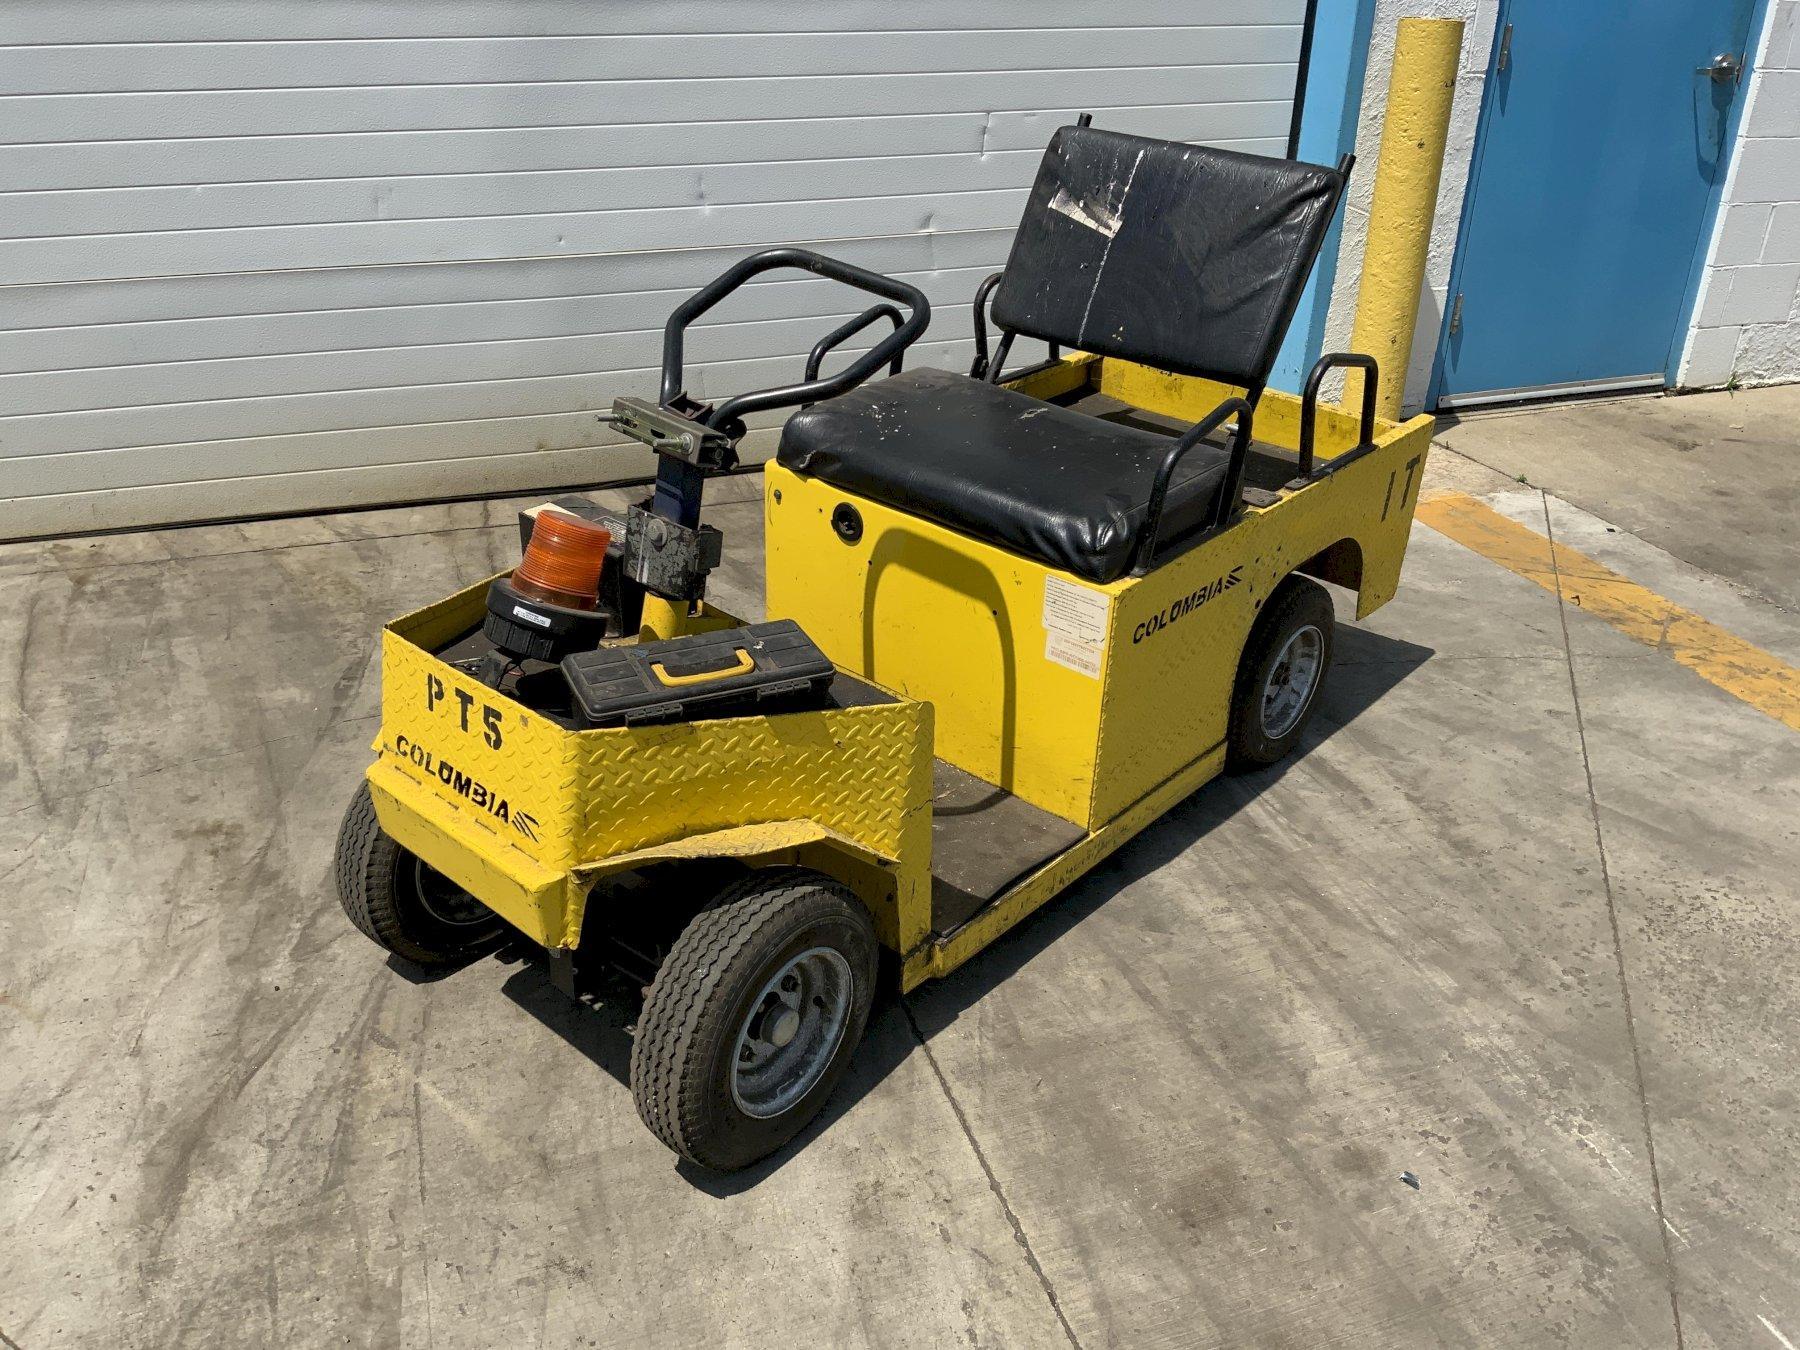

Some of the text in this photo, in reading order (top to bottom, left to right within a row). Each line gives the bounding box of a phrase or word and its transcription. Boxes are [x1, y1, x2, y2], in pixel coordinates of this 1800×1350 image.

[1133, 577, 1222, 644] COLOMBIA
[427, 673, 503, 751] PT5
[396, 735, 509, 824] COLOMBIA
